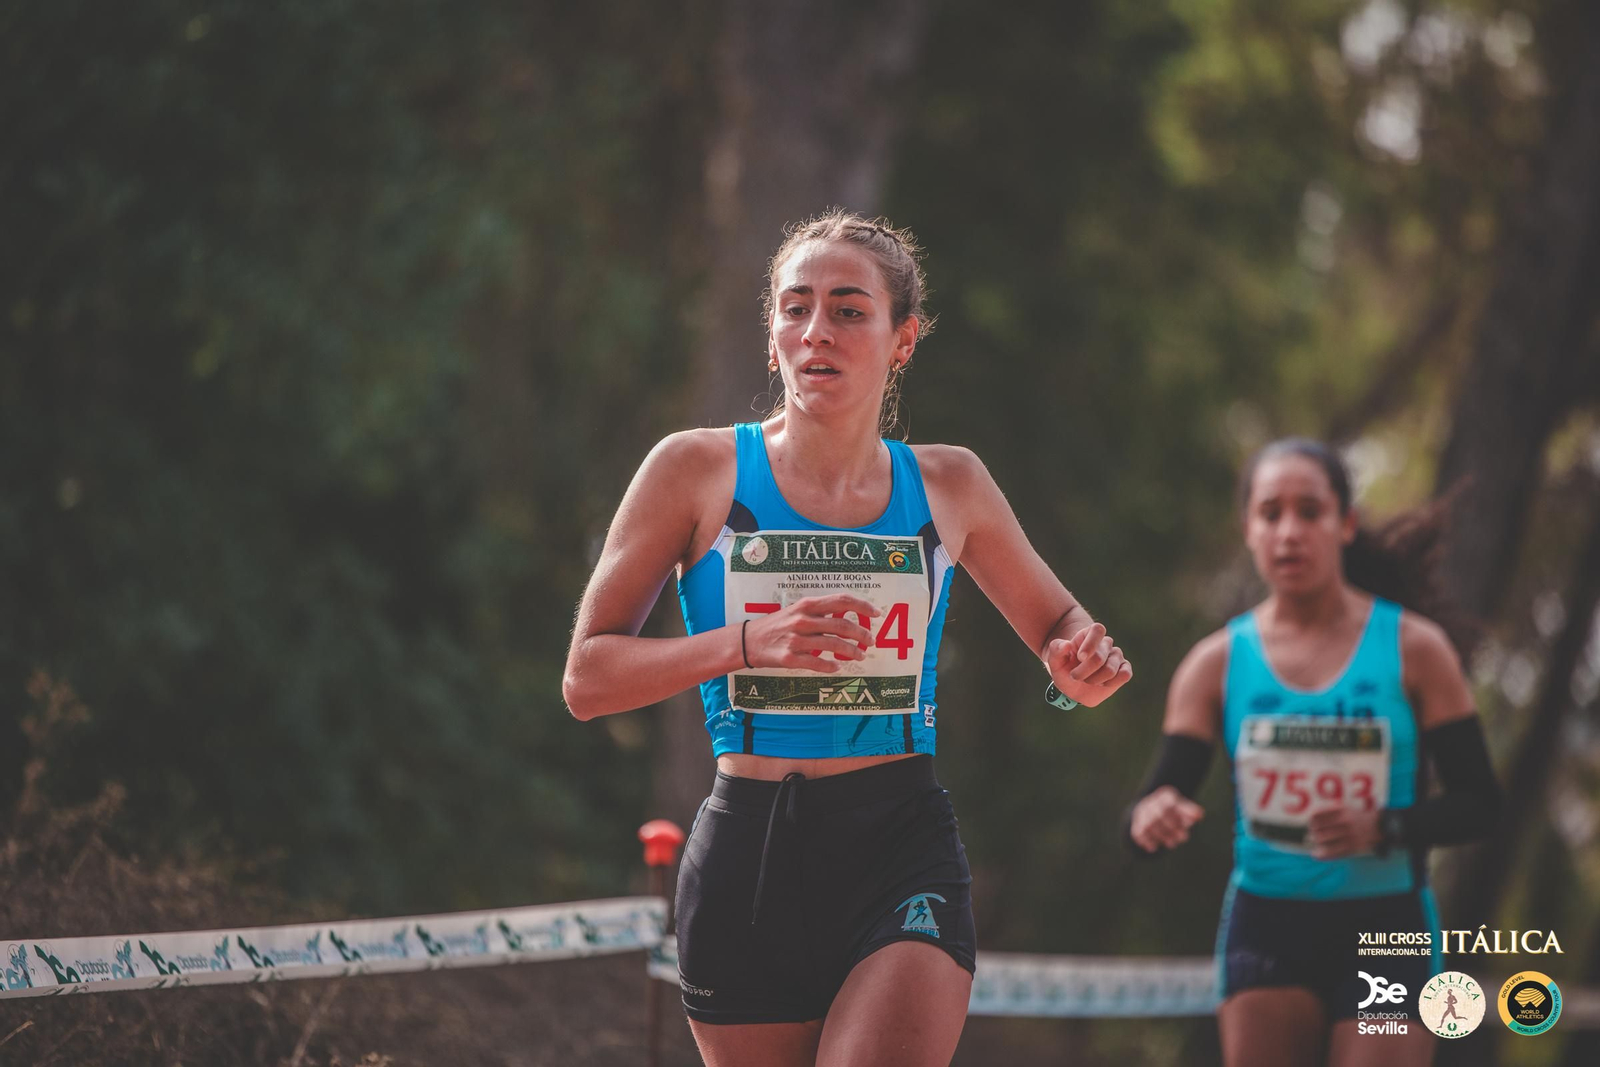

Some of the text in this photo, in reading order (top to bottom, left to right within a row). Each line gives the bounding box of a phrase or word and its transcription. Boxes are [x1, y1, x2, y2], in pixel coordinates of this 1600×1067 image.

[781, 536, 876, 560] ITÁLICA
[786, 573, 819, 581] AINHOA
[821, 573, 842, 581] RUIZ
